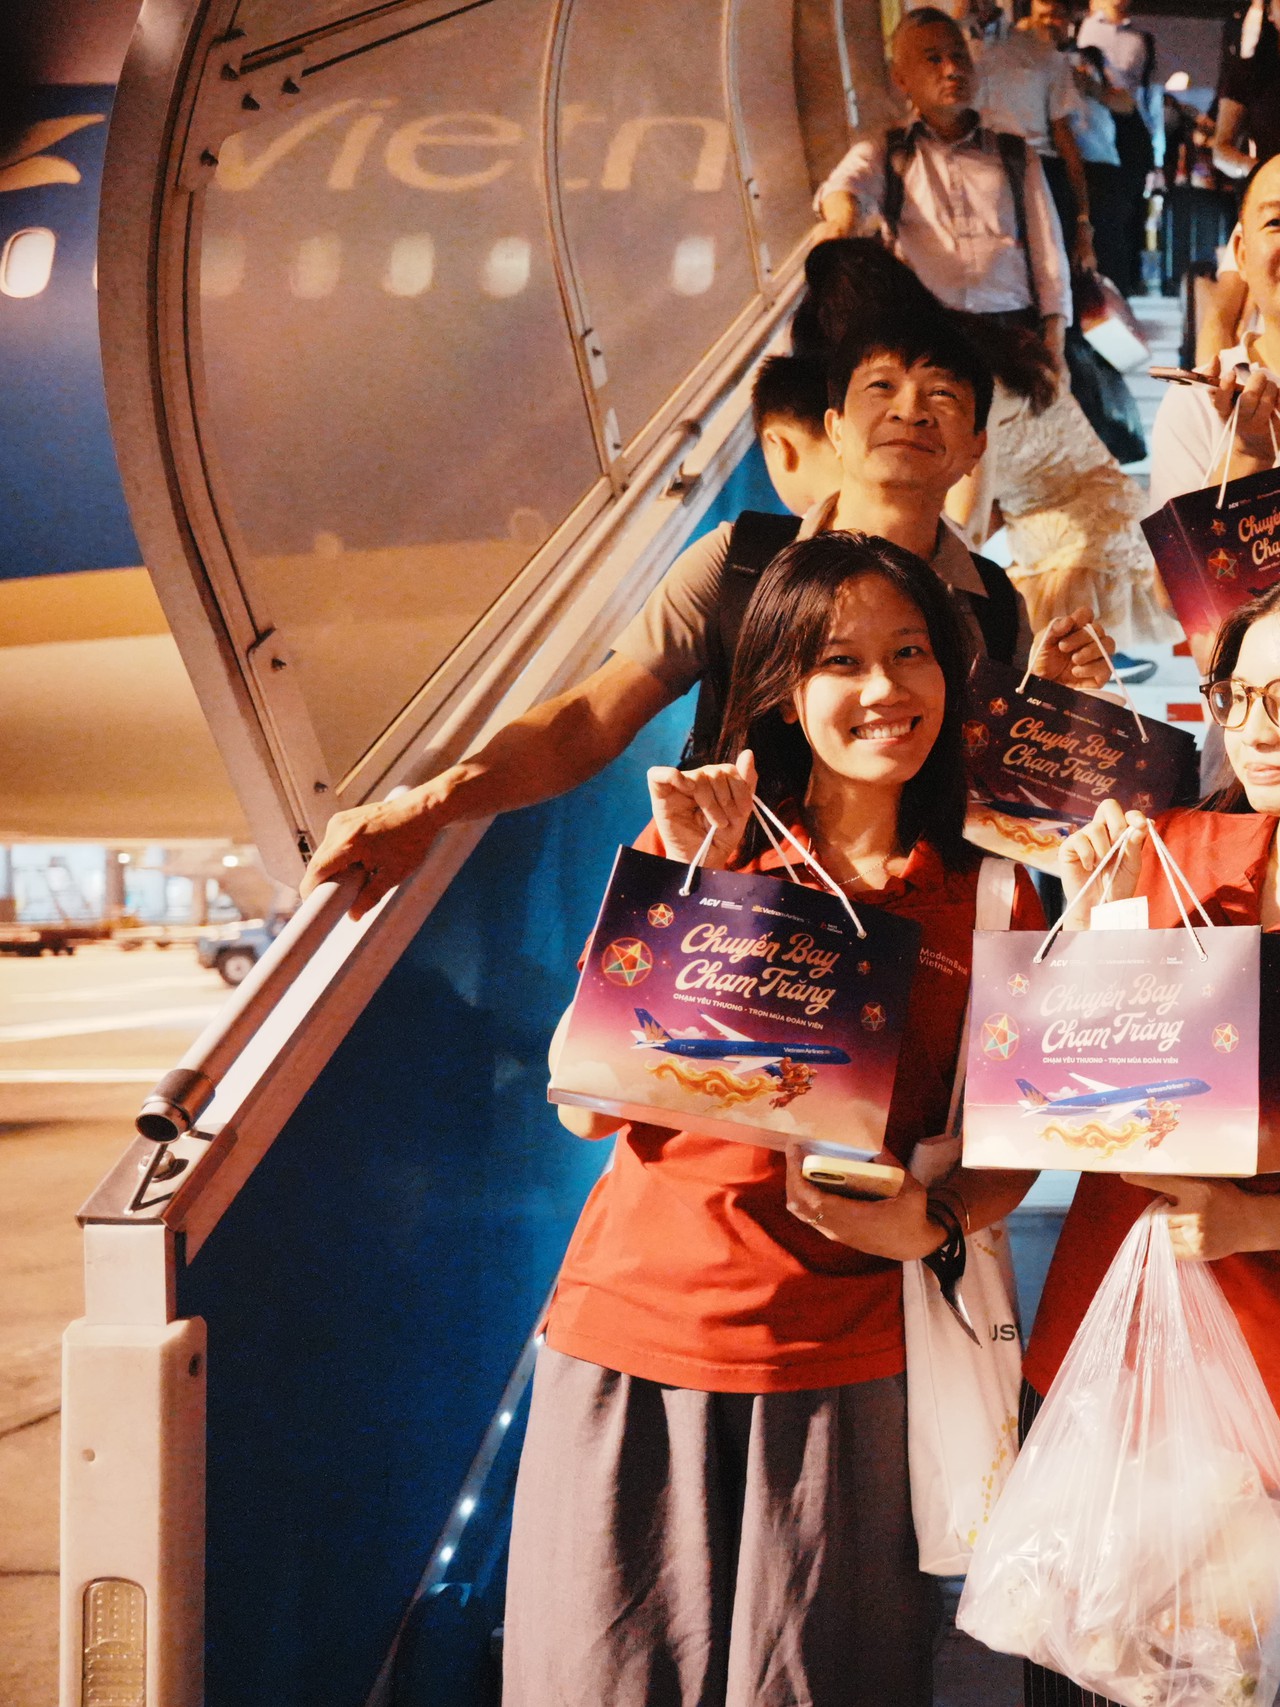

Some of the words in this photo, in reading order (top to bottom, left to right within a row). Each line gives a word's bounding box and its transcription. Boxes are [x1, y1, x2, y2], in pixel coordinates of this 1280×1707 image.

[215, 97, 735, 193] Vietn
[1009, 717, 1080, 754] Chuyến
[1078, 734, 1125, 770] Bay
[1002, 743, 1061, 778] Chạm
[1060, 757, 1117, 796] Trăng
[699, 897, 721, 907] ACV
[680, 923, 781, 964] Chuyến
[781, 933, 841, 979] Bay
[919, 955, 953, 976] Vietnam
[1049, 959, 1069, 968] ACV
[673, 992, 696, 1003] CHẠM
[696, 996, 711, 1006] YÊU
[675, 958, 758, 998] Chạm
[758, 967, 836, 1015] Trăng
[1040, 981, 1126, 1019] Chuyến
[1128, 973, 1183, 1015] Bay
[1041, 1019, 1112, 1053] Chạm
[1112, 1011, 1184, 1052] Trăng
